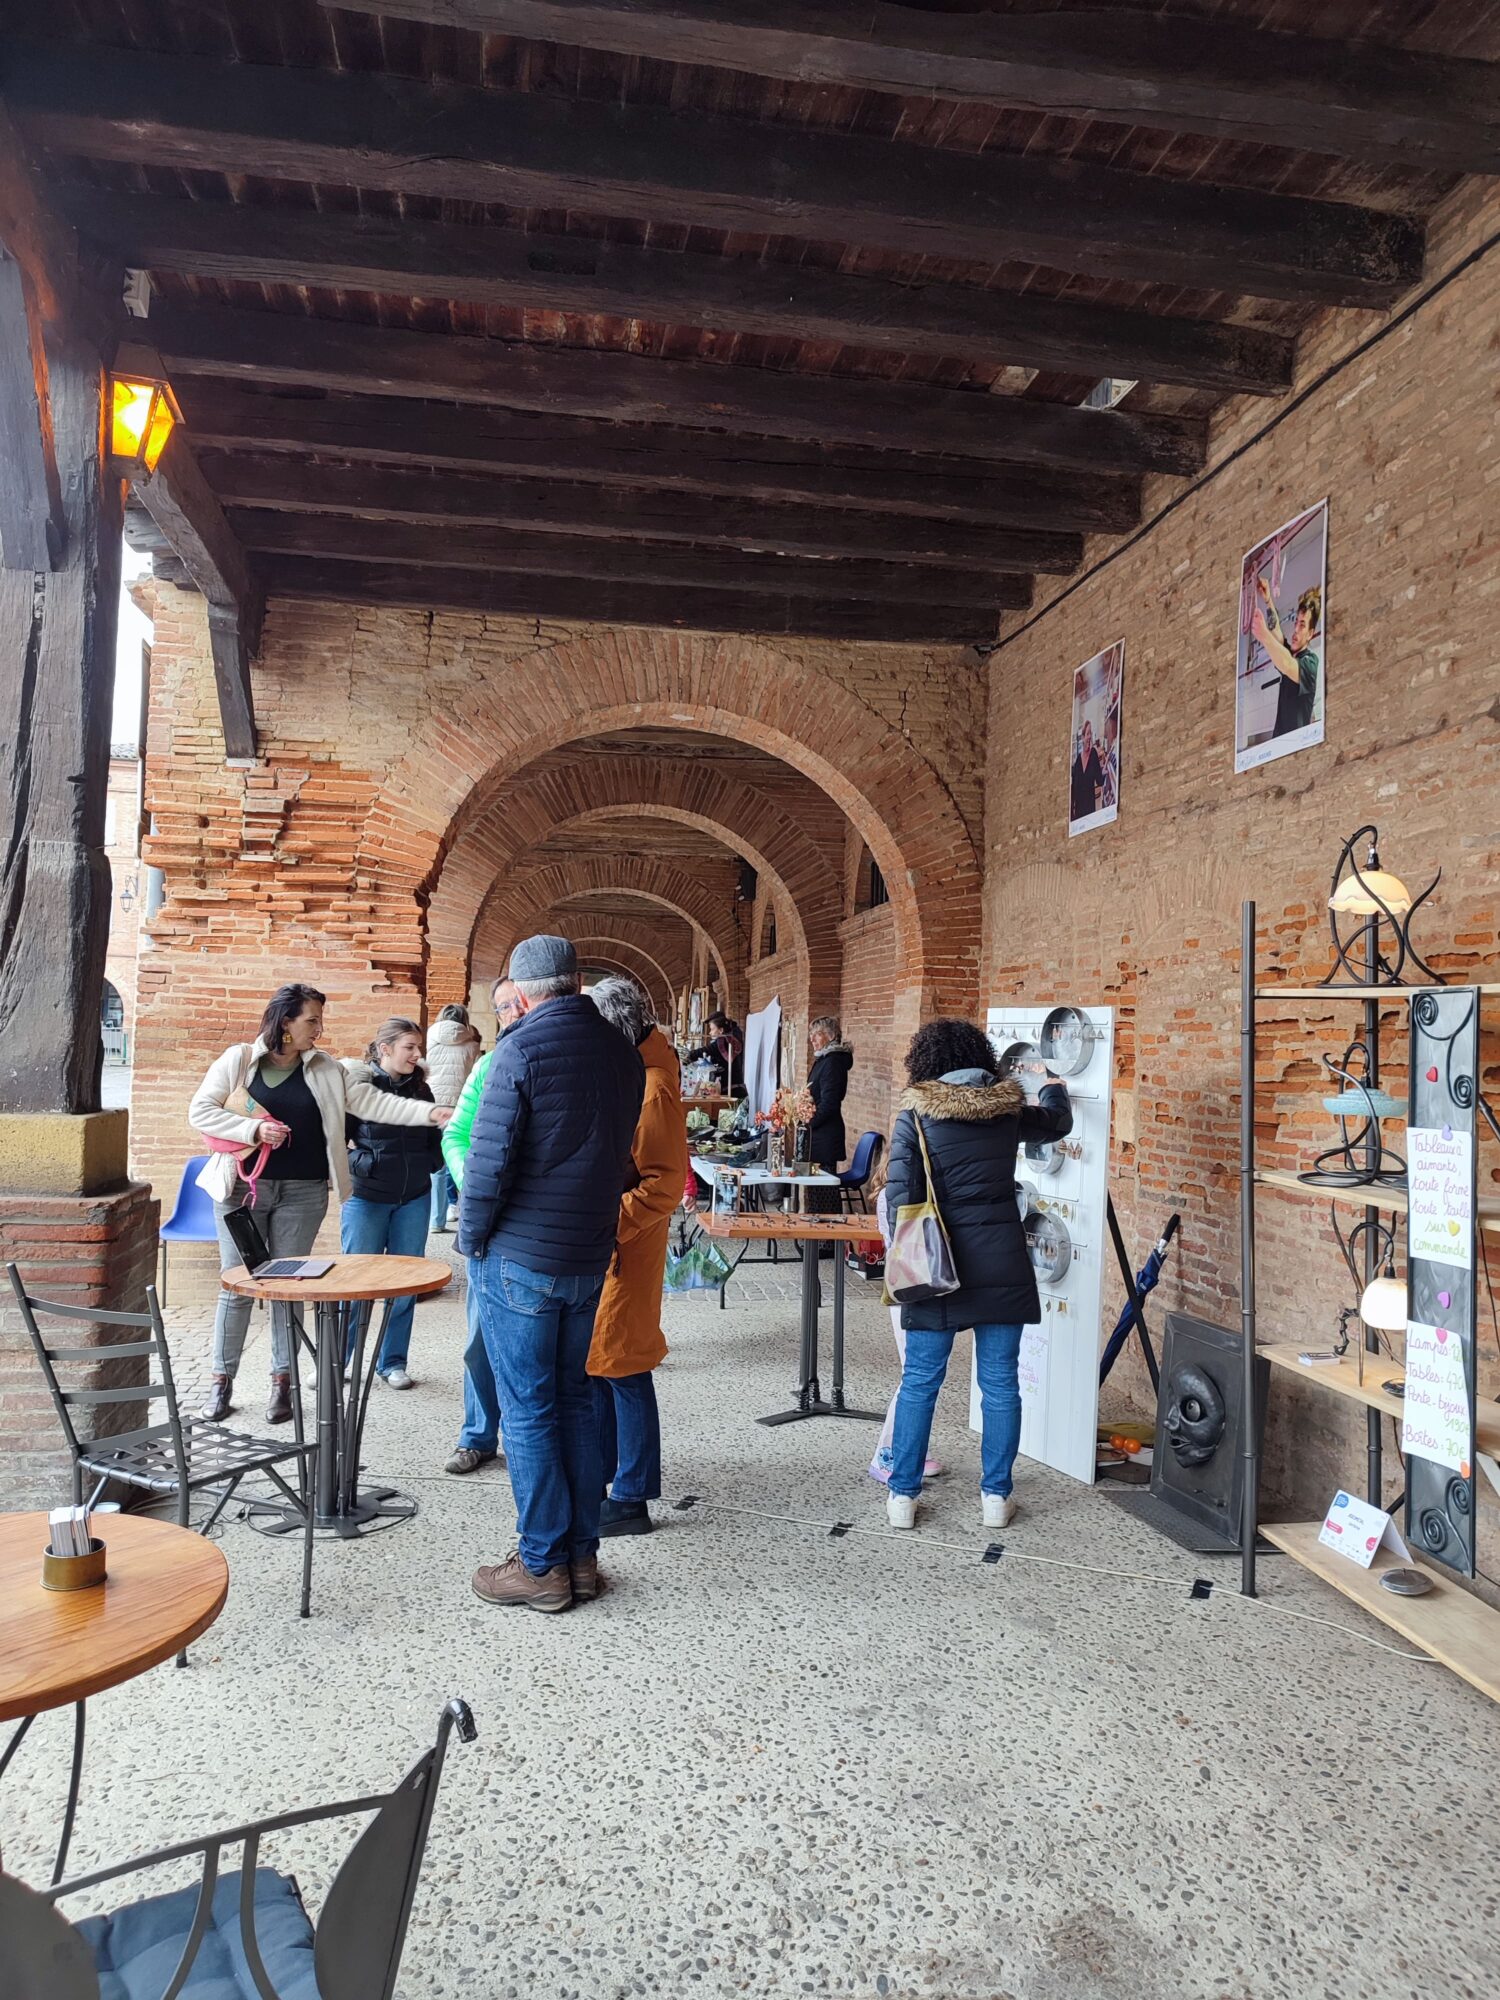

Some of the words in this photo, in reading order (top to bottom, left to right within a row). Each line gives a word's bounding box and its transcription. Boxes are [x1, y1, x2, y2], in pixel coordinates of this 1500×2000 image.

[1411, 1176, 1439, 1192] toute
[1411, 1197, 1437, 1215] toute
[1424, 1220, 1447, 1233] sur
